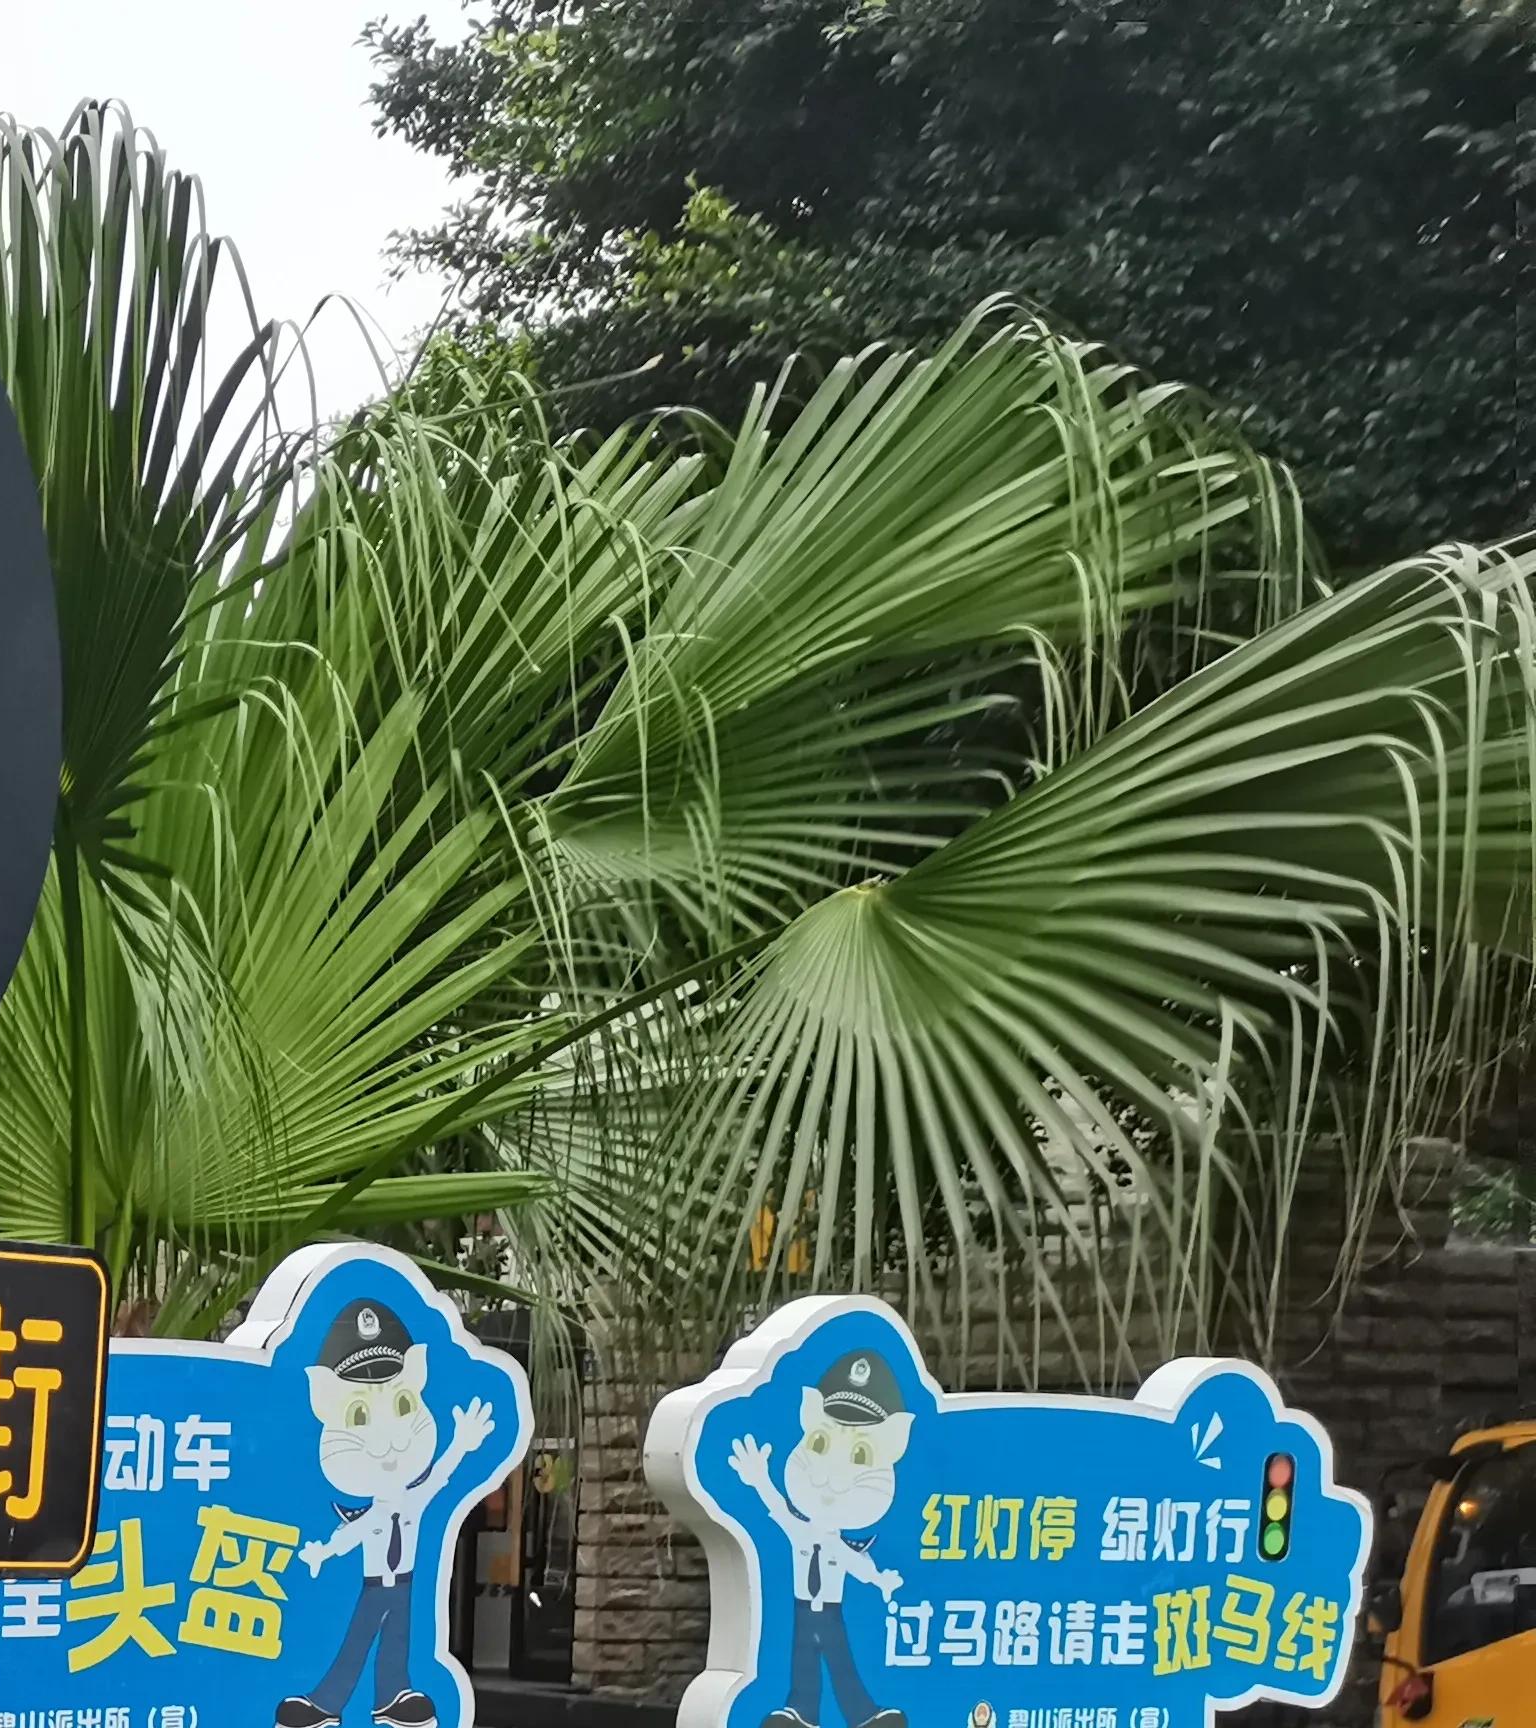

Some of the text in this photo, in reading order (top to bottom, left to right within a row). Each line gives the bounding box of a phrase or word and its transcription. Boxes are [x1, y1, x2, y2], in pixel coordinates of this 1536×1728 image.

[919, 1492, 1252, 1564] 红灯停 绿灯行
[884, 1574, 1340, 1681] 过马路请走斑马线
